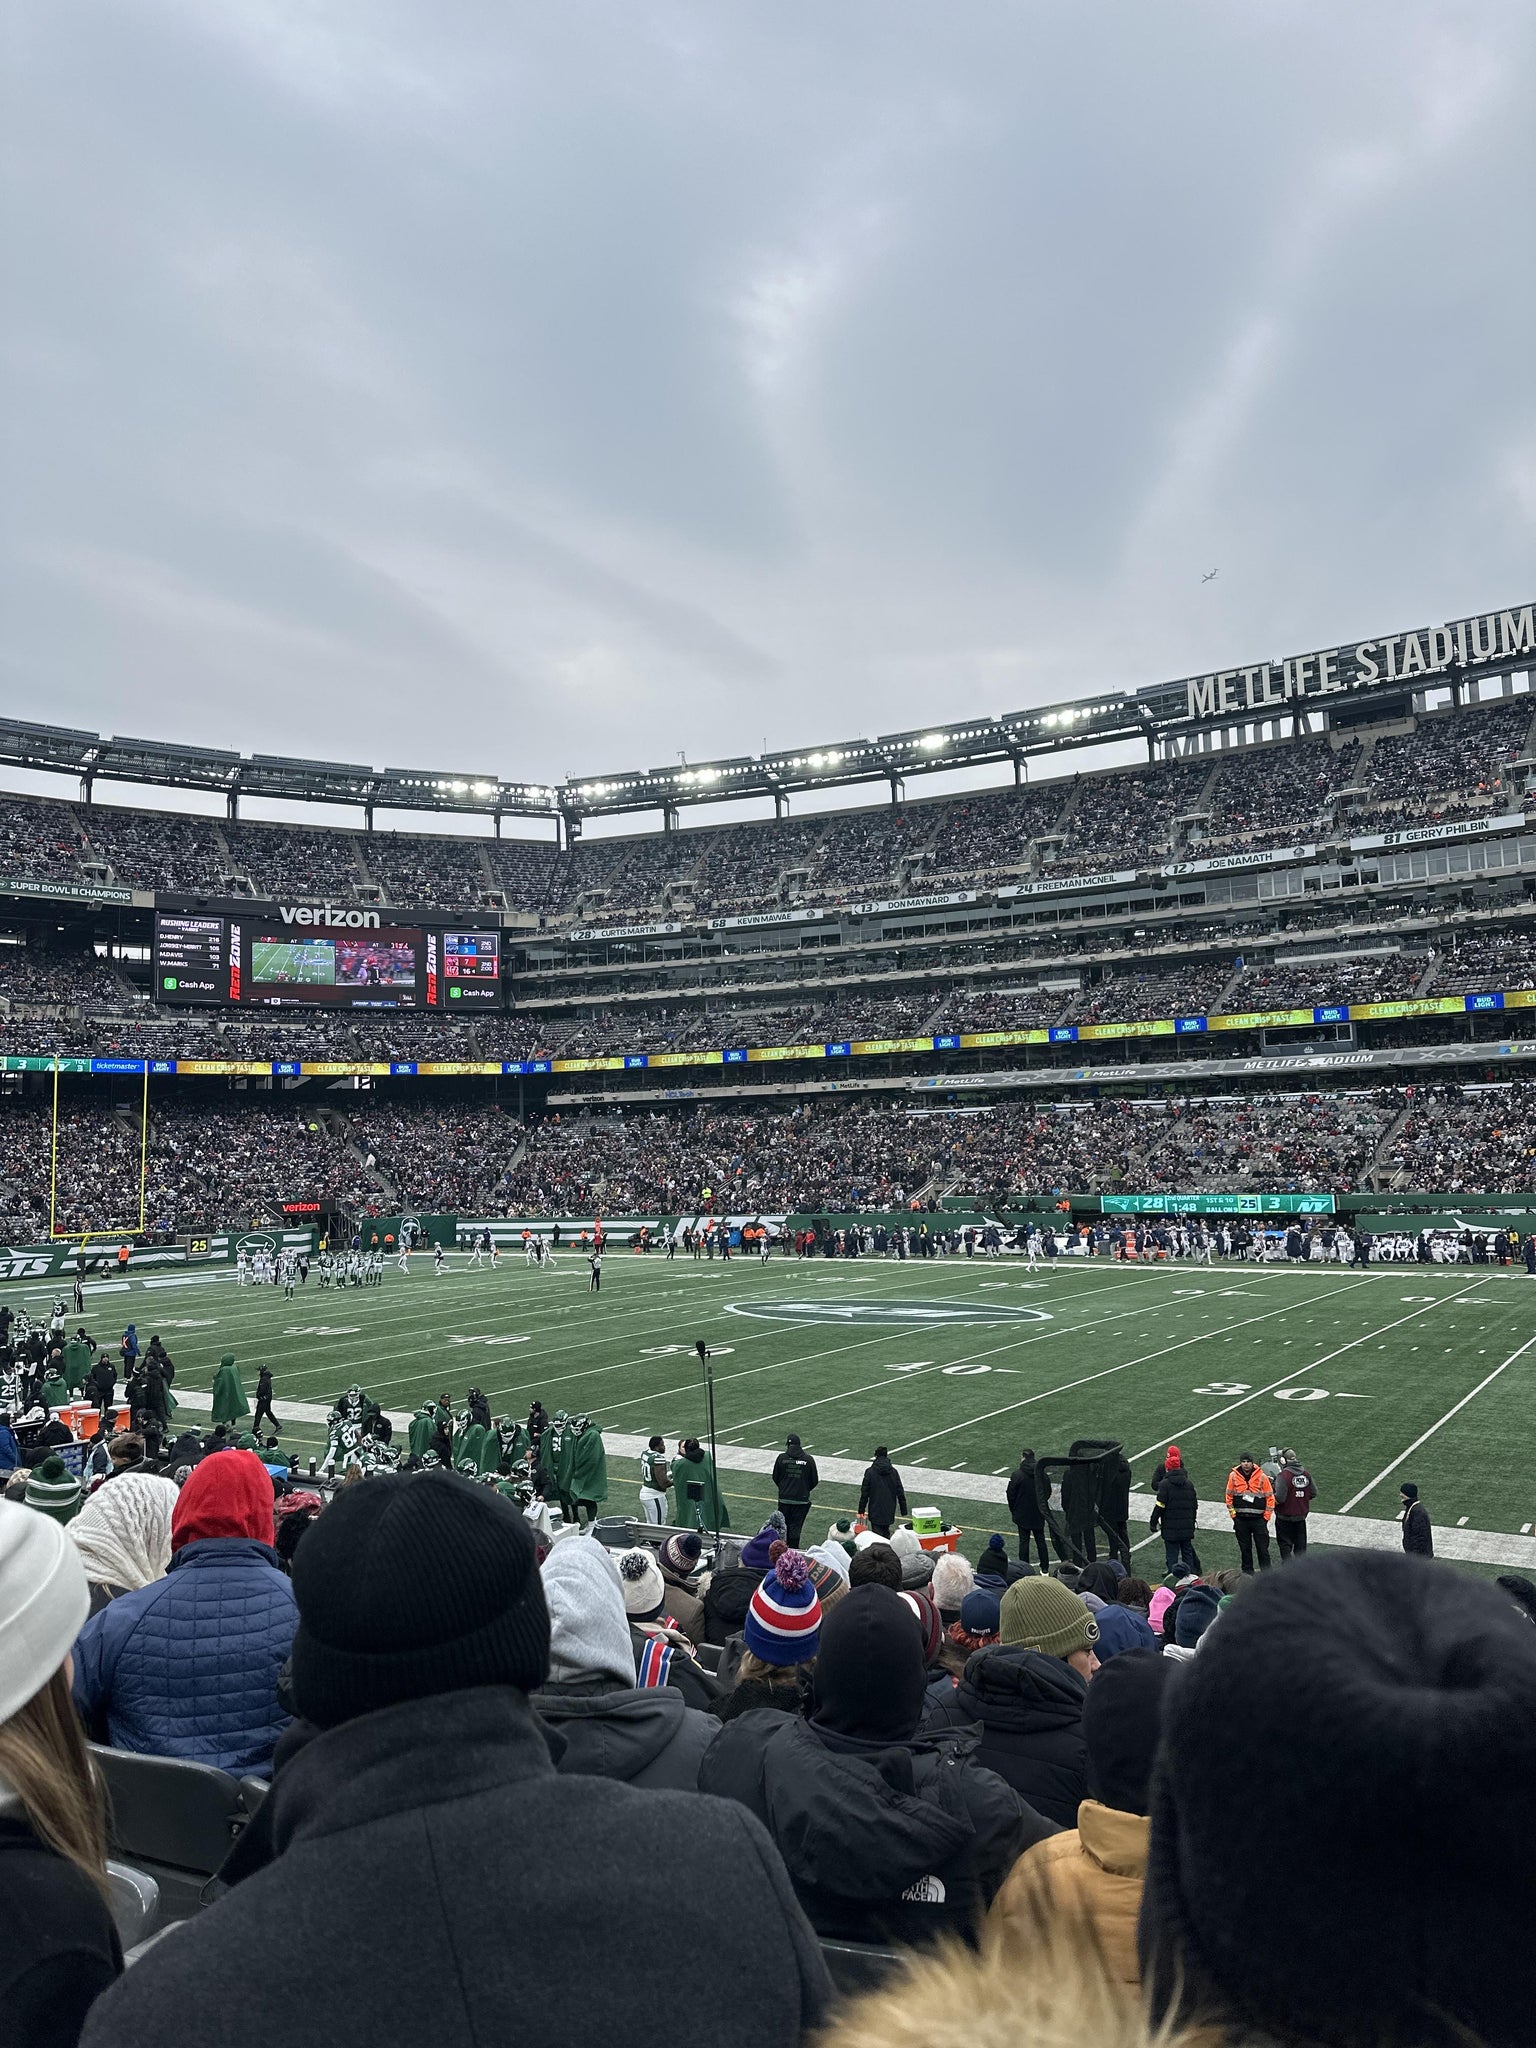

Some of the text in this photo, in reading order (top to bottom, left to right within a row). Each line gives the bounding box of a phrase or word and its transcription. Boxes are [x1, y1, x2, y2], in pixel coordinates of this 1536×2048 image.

[1186, 607, 1536, 717] METLIFE STADIUM
[1384, 819, 1490, 844] 81 GERRY PHILBIN
[1206, 859, 1226, 870] JOE
[1228, 852, 1273, 867] NAMATH
[10, 881, 40, 891] SUPER
[42, 885, 70, 894] BOWL
[80, 889, 131, 900] CHAMPIONS
[1016, 875, 1117, 895] 24 FREEMAN MCNEIL
[887, 901, 908, 910] DON
[907, 895, 950, 907] MAYNARD
[279, 905, 380, 929] verizon
[712, 913, 792, 928] 68 KEVIN MAWAE
[160, 919, 220, 930] RUSHING LEADERS
[601, 929, 627, 938] CURTIS
[627, 926, 657, 935] MARTIN
[179, 981, 215, 991] Cash App
[480, 990, 495, 998] App
[1369, 1002, 1444, 1016] CLEAN CRISP TASTE
[1473, 1001, 1496, 1009] LIGHT
[17, 1060, 27, 1069] 3
[1243, 1054, 1374, 1070] METLIFE ADIUM
[582, 1095, 605, 1103] verizon
[282, 1201, 320, 1213] verizon
[1142, 1198, 1164, 1209] 28
[1172, 1203, 1197, 1212] 1:48
[1240, 1199, 1257, 1210] 25
[1268, 1197, 1280, 1210] 3
[191, 1240, 207, 1252] 25
[1, 1384, 16, 1396] 25
[347, 1407, 362, 1420] 32
[902, 1890, 928, 1902] FACE
